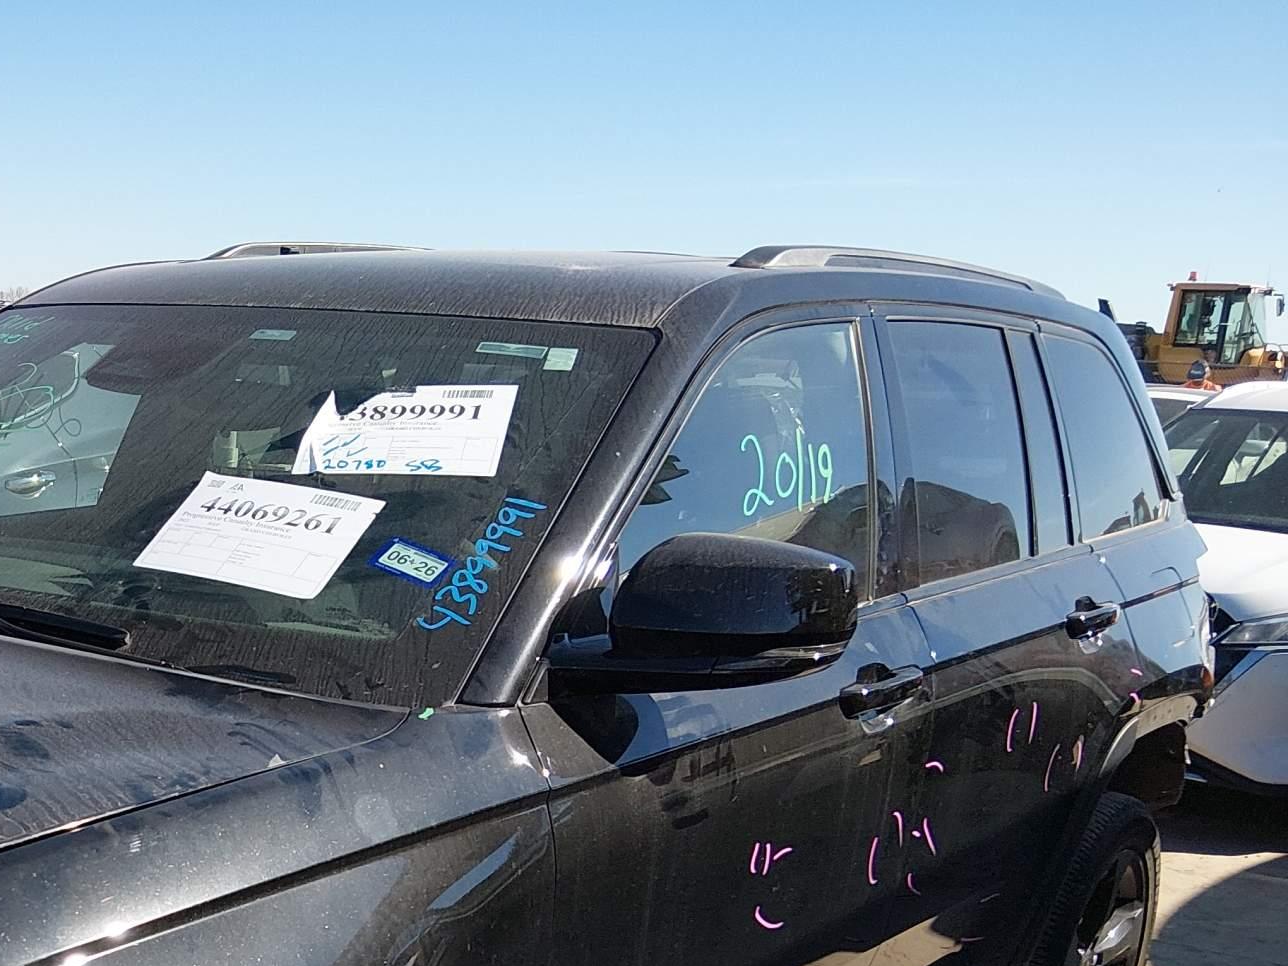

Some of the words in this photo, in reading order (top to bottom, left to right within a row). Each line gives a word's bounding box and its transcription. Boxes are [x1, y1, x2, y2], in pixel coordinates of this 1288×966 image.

[338, 403, 483, 421] 3899991
[200, 495, 343, 534] 44069261
[415, 497, 548, 631] 43899991
